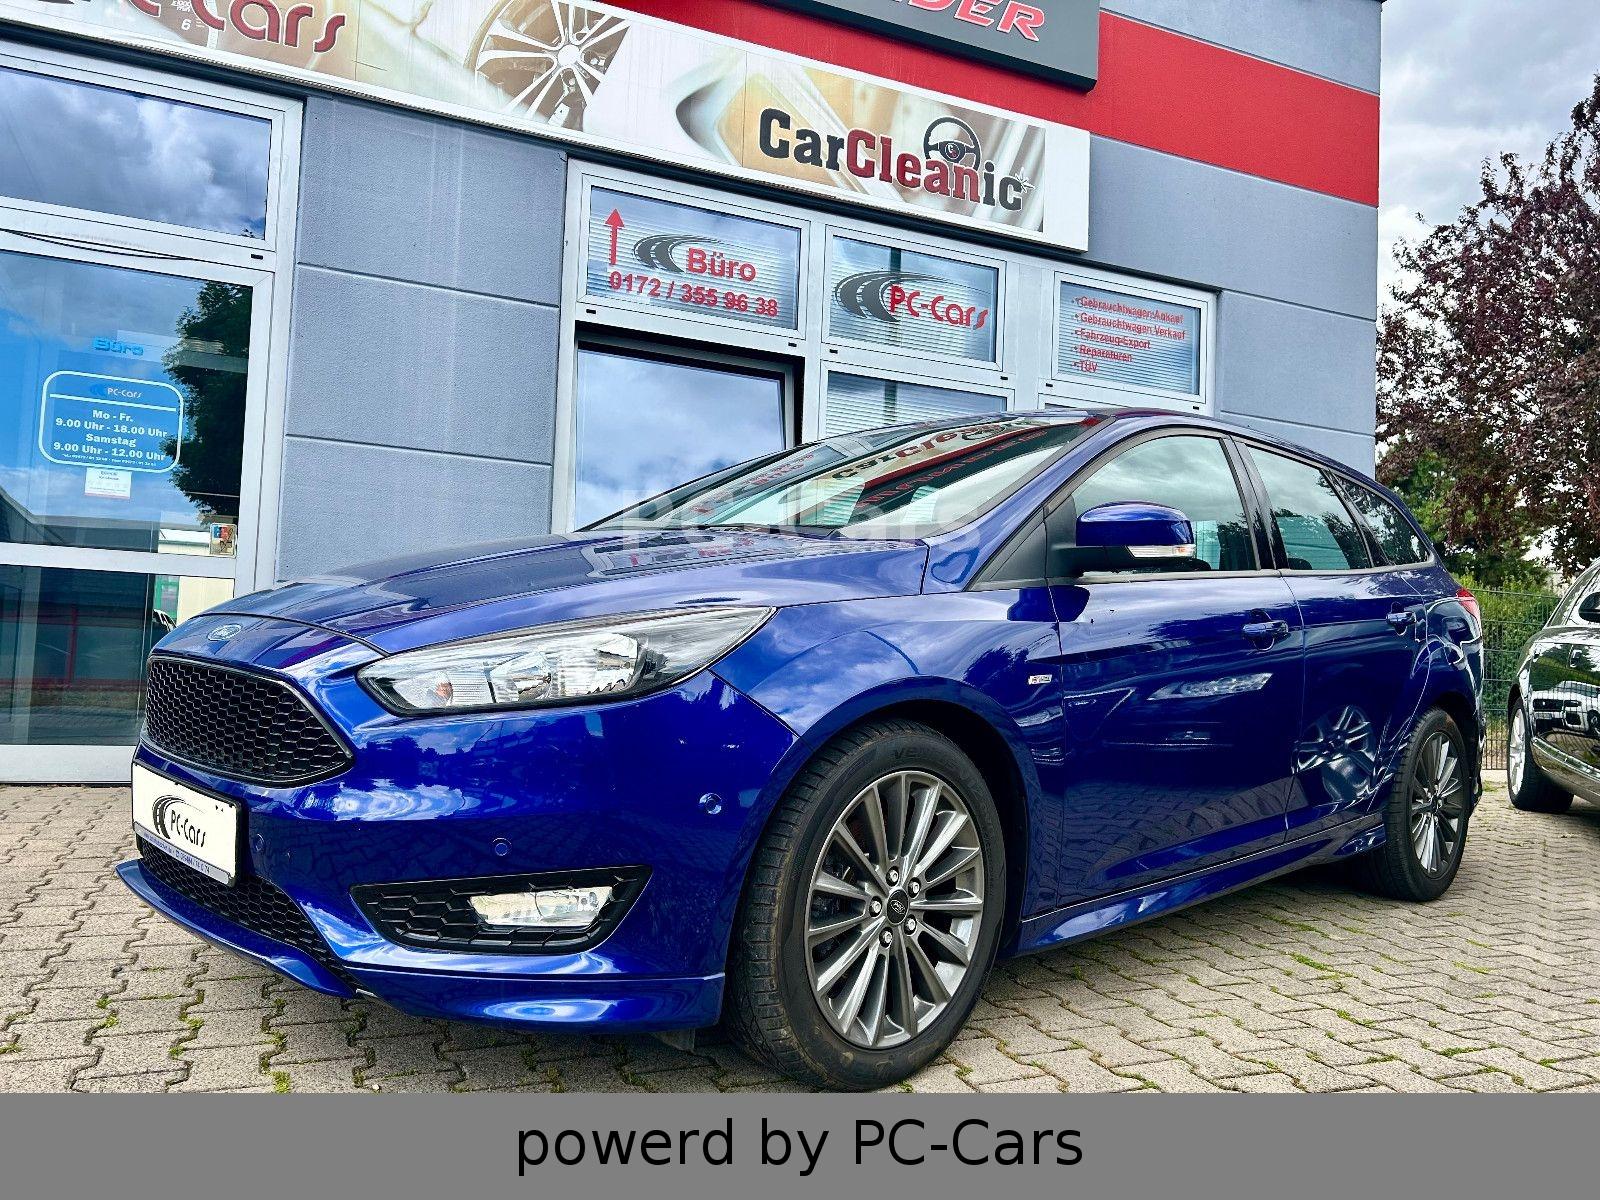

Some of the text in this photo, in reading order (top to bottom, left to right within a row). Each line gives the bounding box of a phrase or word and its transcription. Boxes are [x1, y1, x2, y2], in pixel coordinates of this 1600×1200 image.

[759, 107, 1023, 212] CarCleanic
[687, 247, 757, 282] Büro
[609, 270, 662, 297] 0172
[667, 280, 675, 299] /
[680, 283, 718, 307] 355
[755, 296, 778, 318] 38
[889, 285, 989, 330] PC-Cars
[107, 387, 142, 399] PC-Cars
[55, 417, 81, 428] 9.00
[84, 420, 105, 431] Uhr
[113, 424, 145, 435] 18.00
[147, 427, 168, 438] Uhr
[92, 409, 111, 420] Mo
[119, 412, 134, 422] Fr.
[53, 441, 79, 452] 9.00
[82, 444, 103, 455] Uhr
[111, 447, 143, 459] 12.00
[145, 450, 166, 461] Uhr
[85, 433, 137, 448] Samstag
[170, 809, 207, 848] PC-Cars
